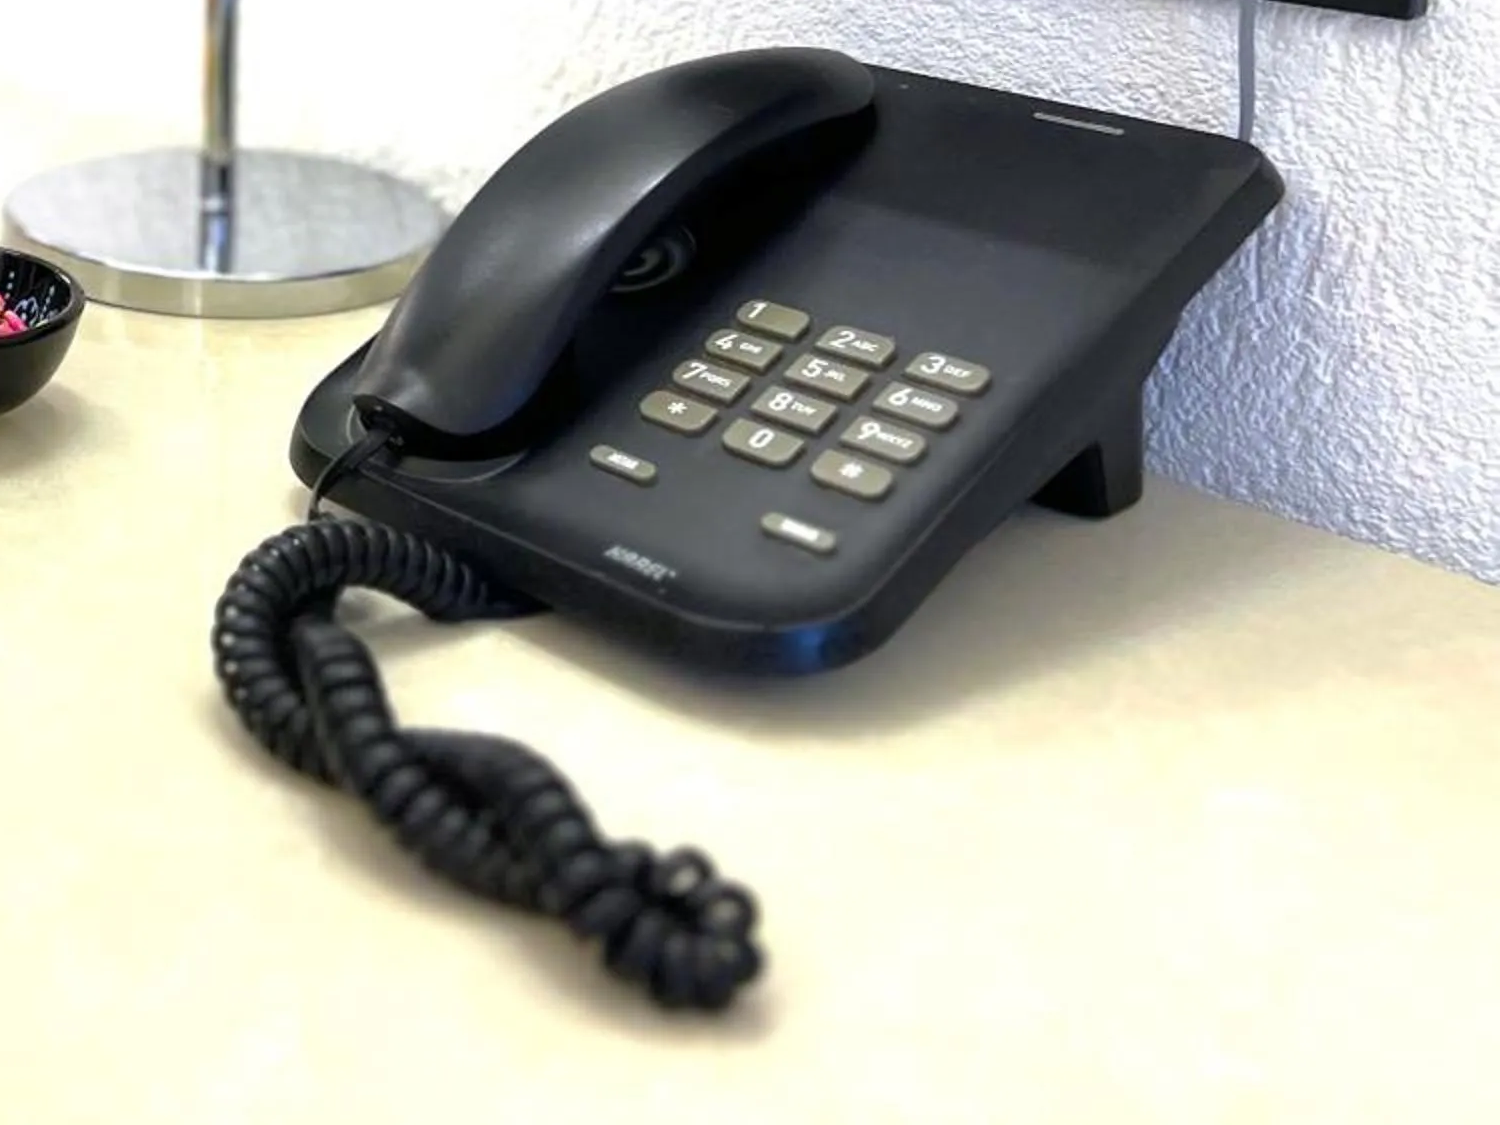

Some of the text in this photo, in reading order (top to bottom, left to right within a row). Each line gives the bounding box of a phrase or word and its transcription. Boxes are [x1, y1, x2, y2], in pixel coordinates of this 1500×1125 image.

[748, 302, 767, 318] 1
[714, 334, 738, 350] 4
[829, 330, 856, 349] 2
[681, 362, 708, 379] 7
[801, 358, 829, 378] 5
[919, 355, 946, 374] 3
[767, 391, 794, 412] 8
[887, 387, 914, 407] 6
[748, 428, 775, 449] 0
[856, 421, 882, 441] 9
